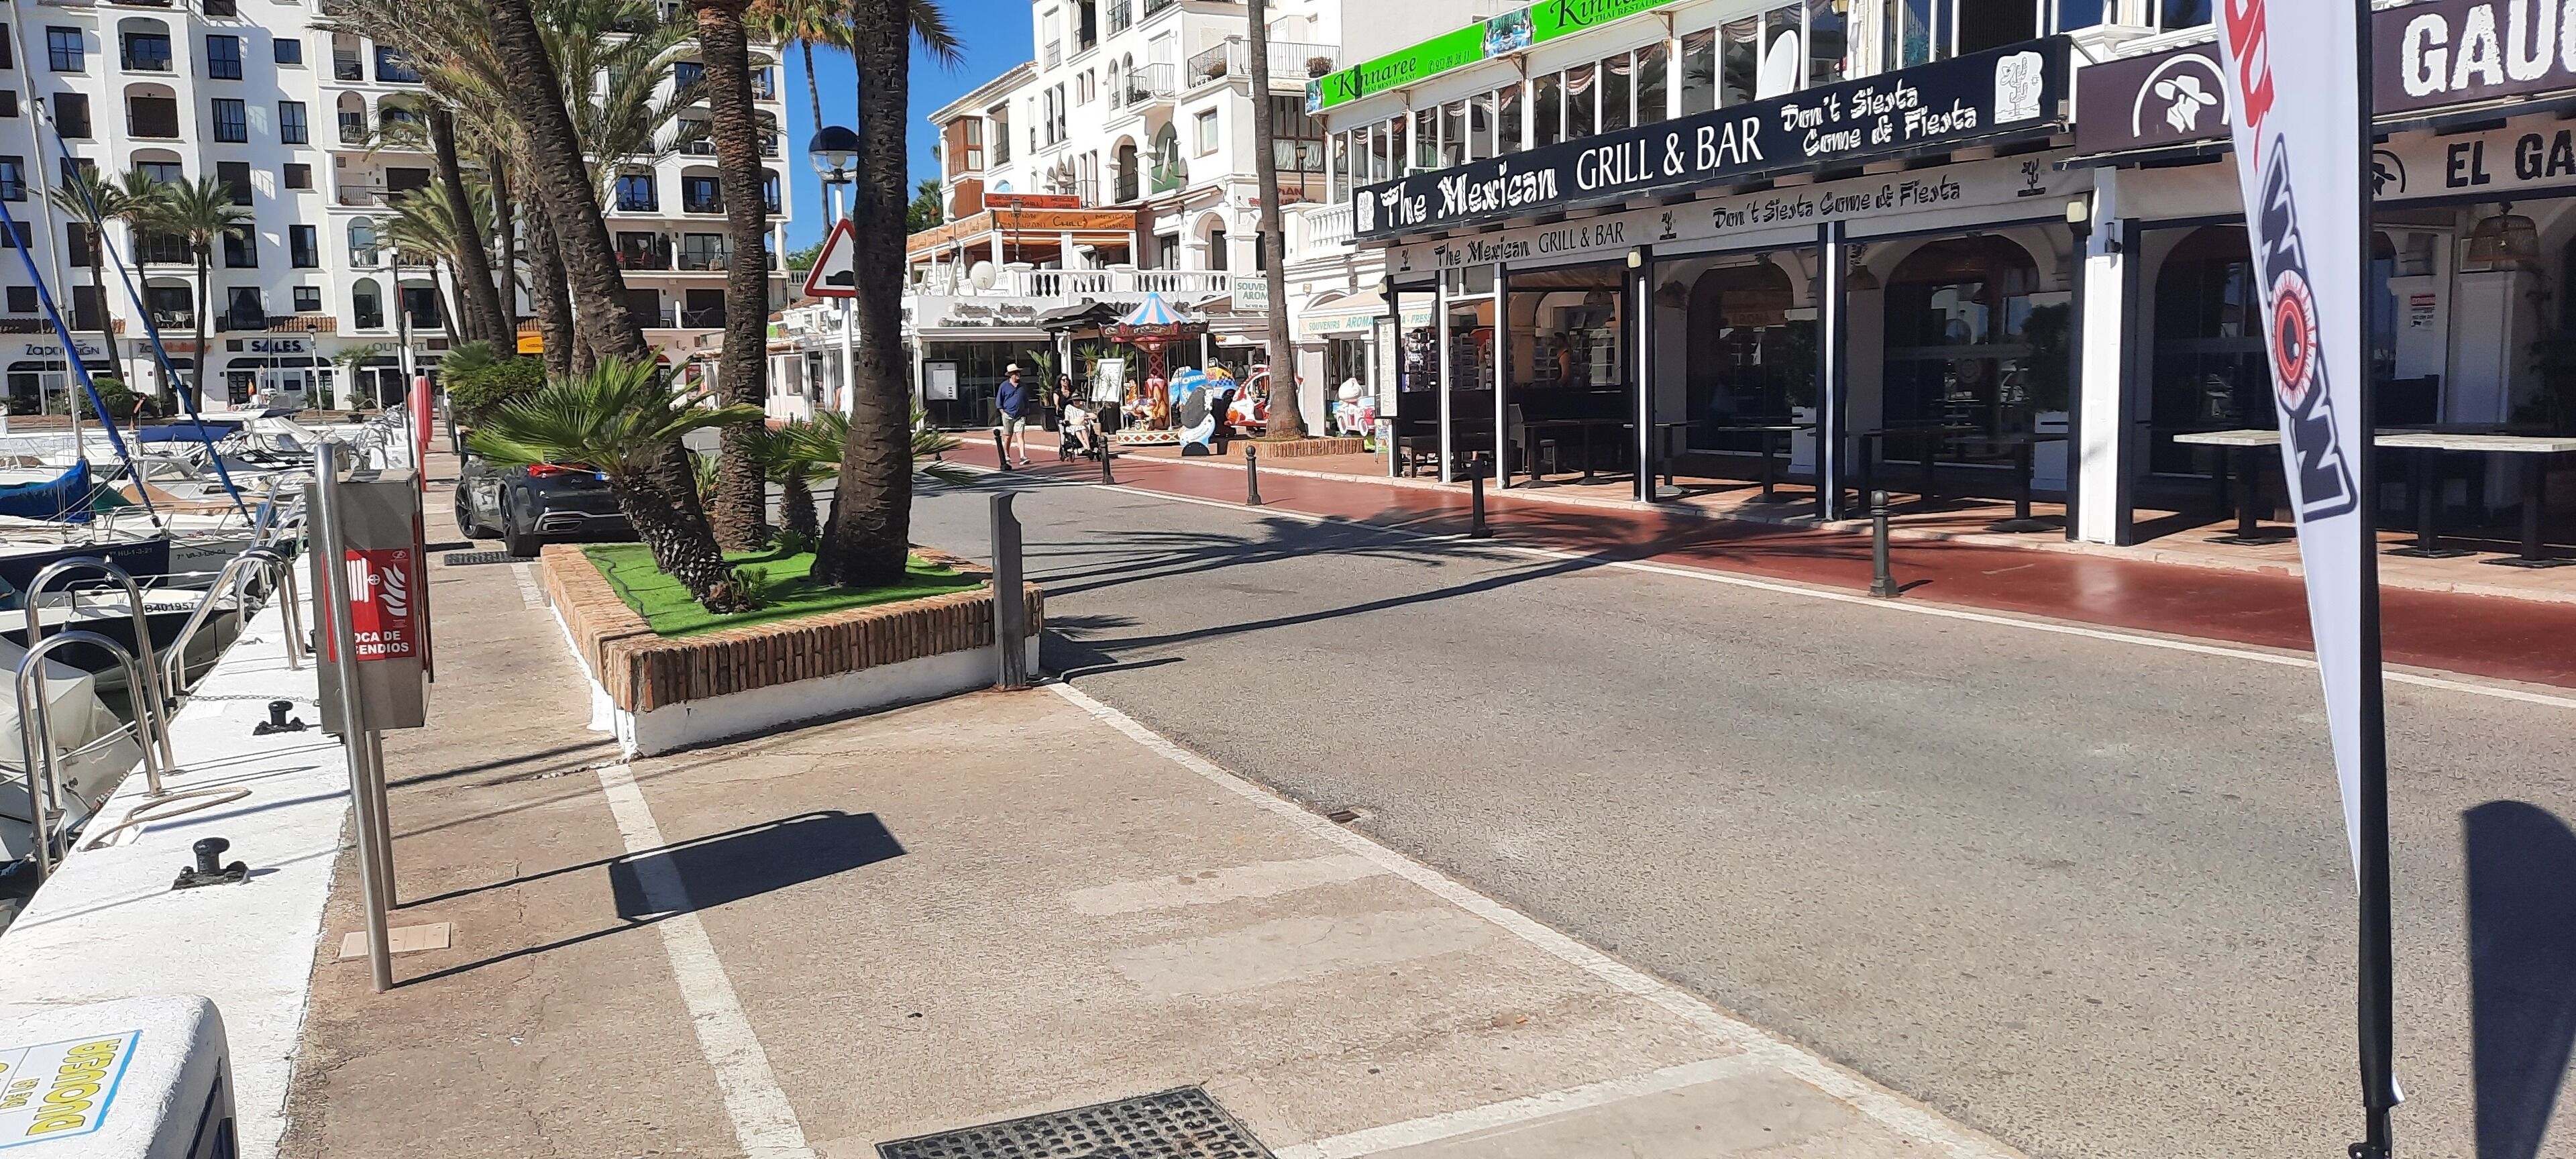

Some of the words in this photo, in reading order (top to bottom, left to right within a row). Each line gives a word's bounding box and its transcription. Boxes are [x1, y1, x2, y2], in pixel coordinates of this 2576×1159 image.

[1333, 56, 1417, 98] Knnaree
[1377, 73, 1416, 91] RESTAURANT
[1780, 94, 1841, 133] Don't
[1849, 78, 1919, 120] Siesta
[1802, 128, 1862, 158] Come
[1871, 114, 1894, 146] &
[1904, 97, 1978, 142] Fiesta
[1380, 180, 1428, 229] The
[1437, 160, 1559, 220] Mexican
[1576, 140, 1654, 192] GRILL
[1662, 133, 1686, 177] &
[1695, 115, 1765, 172] BAR
[2446, 140, 2490, 189] EL
[1712, 203, 1759, 230] Don't
[1762, 199, 1814, 225] Siesta
[1819, 190, 1871, 217] Come
[1876, 184, 1894, 210] &
[1899, 174, 1961, 209] Fiesta
[1434, 241, 1462, 268] The
[1467, 234, 1531, 264] Mexican
[1539, 229, 1578, 254] GRILL
[1580, 227, 1591, 248] &
[1595, 221, 1625, 245] BAR
[354, 632, 380, 643] OCA
[383, 630, 401, 641] DE
[25, 1038, 123, 1136] DUQUESA
